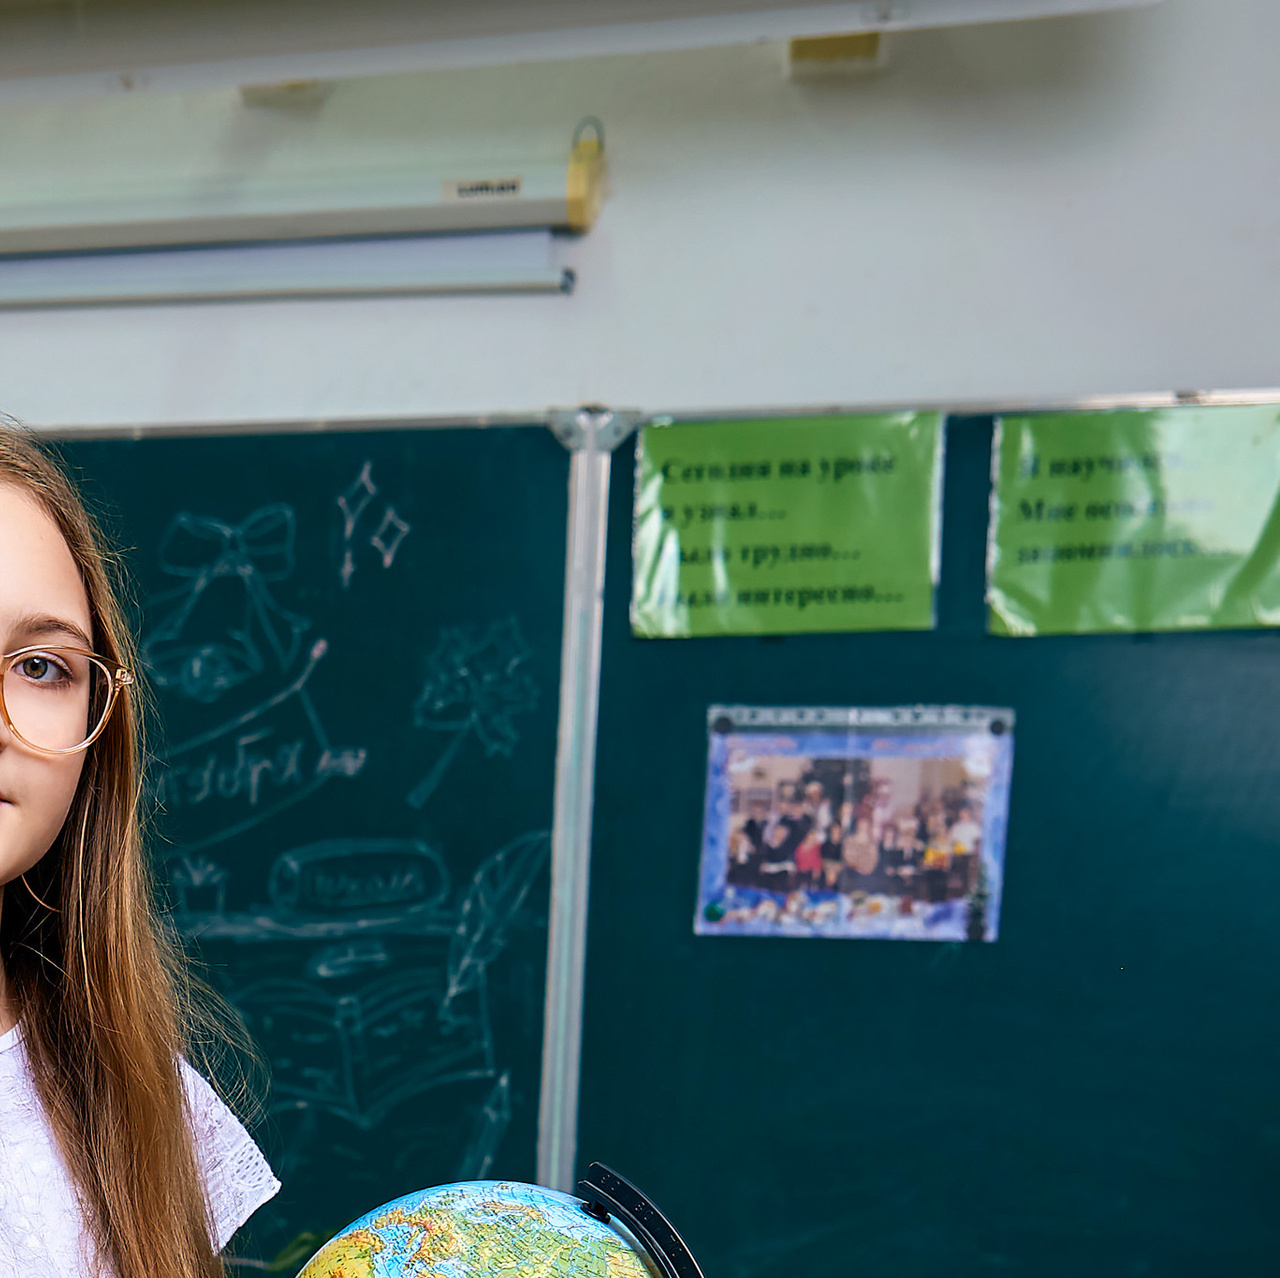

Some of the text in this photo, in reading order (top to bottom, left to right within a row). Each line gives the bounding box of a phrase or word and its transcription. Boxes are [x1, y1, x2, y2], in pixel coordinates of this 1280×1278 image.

[661, 457, 897, 483] Сегодня на уроке
